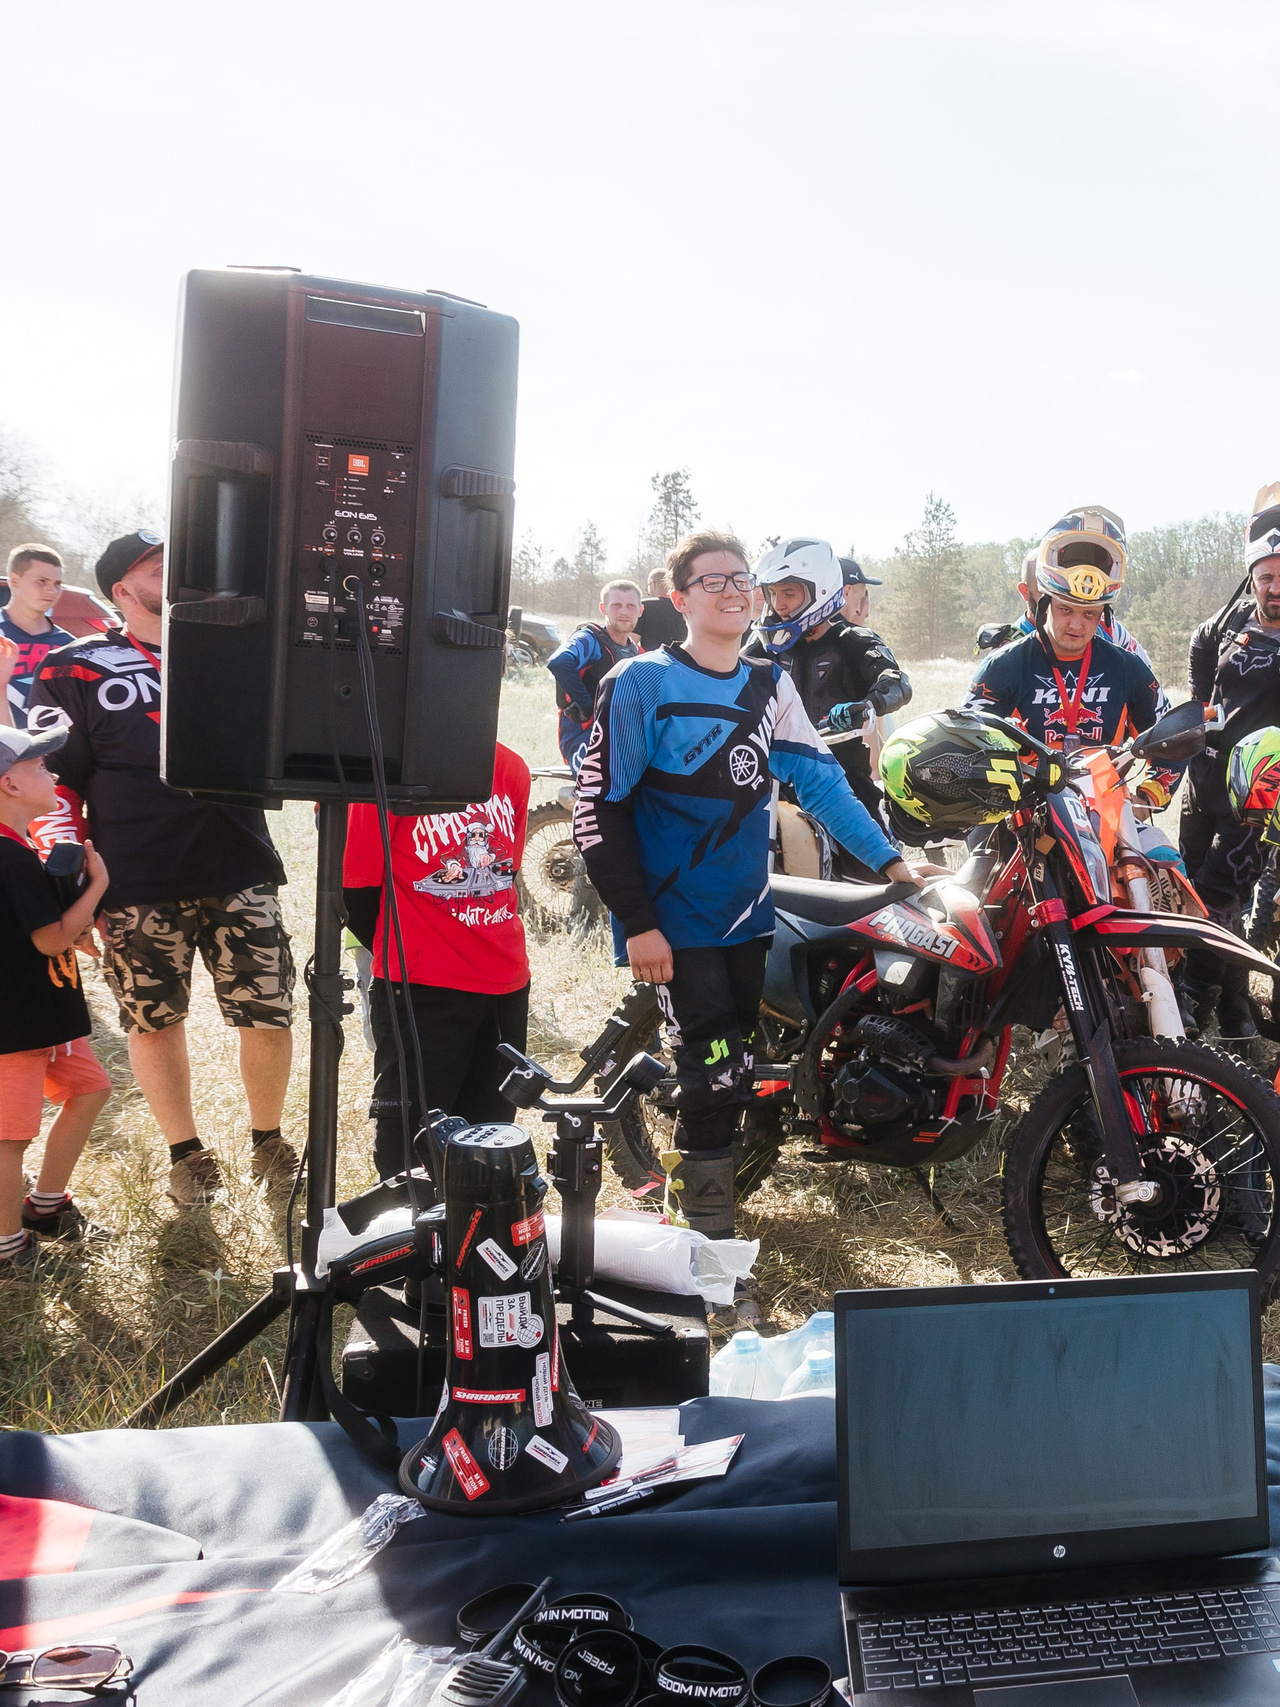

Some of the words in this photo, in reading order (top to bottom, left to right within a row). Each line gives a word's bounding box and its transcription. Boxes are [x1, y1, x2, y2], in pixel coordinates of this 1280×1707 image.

[352, 458, 366, 468] JBL
[334, 509, 357, 519] EON
[359, 512, 378, 521] 615
[799, 589, 845, 633] 100%
[683, 723, 724, 767] GYTR
[572, 751, 604, 852] YAMAHA
[868, 910, 962, 960] PROGASI
[456, 1208, 483, 1270] SHARMAX
[507, 1298, 515, 1311] ЗА
[518, 1295, 528, 1330] ВЫЙДИ
[495, 1299, 506, 1344] ПРЕДЕЛЫ
[454, 1390, 521, 1401] SHARMAX
[458, 1446, 471, 1466] FREED
[561, 1608, 609, 1621] MOTION
[522, 1648, 535, 1662] IN
[694, 1686, 709, 1698] IN
